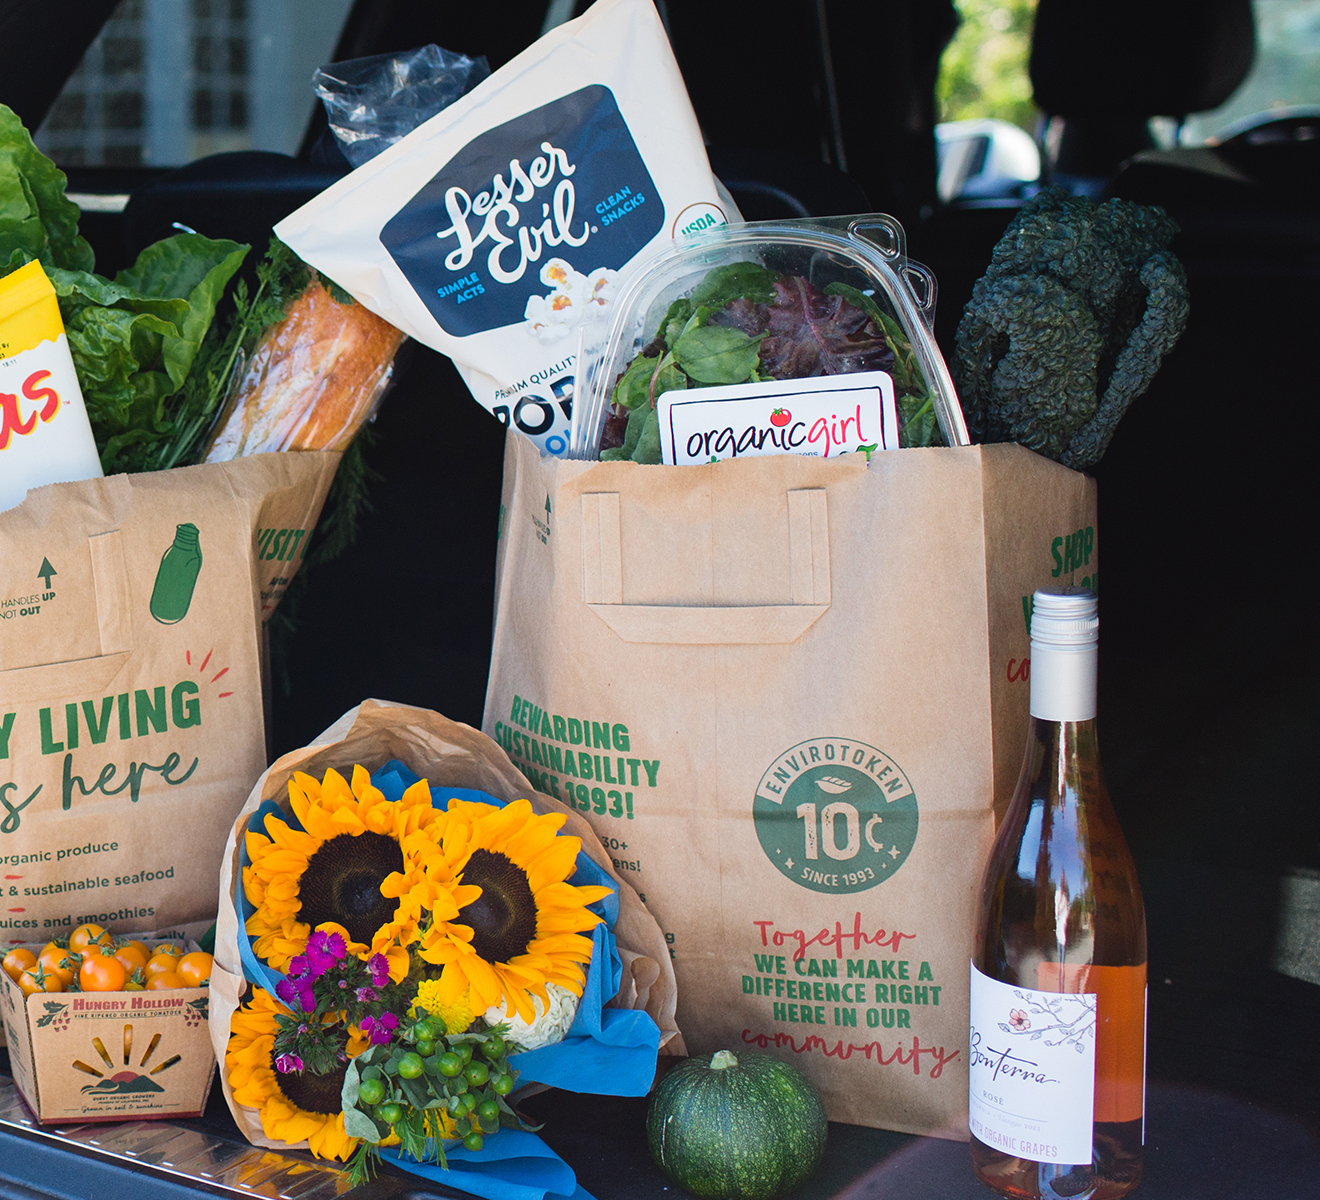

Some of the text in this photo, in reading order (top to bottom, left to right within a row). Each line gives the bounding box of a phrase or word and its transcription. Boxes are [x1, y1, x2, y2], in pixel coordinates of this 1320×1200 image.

[436, 141, 576, 271] Lesser
[594, 185, 632, 215] CLEAN
[600, 192, 646, 227] SNACKS
[437, 271, 480, 299] SIMPLE
[457, 284, 486, 304] ACTS
[686, 404, 868, 458] organicgirl
[257, 528, 306, 562] VISIT
[1051, 526, 1094, 578] SHOP
[1, 594, 40, 609] HANDLES
[41, 591, 56, 602] UP
[20, 605, 41, 617] OUT
[38, 680, 202, 756] LIVING
[510, 694, 631, 752] REWARDING
[495, 720, 661, 788] SUSTAINABILITY
[765, 743, 904, 795] ENVIROTOKEN
[63, 752, 199, 812] here
[565, 781, 635, 820] 1993!
[796, 801, 884, 861] 10¢
[56, 841, 119, 862] produce
[8, 885, 19, 897] &
[23, 876, 110, 897] sustainable
[114, 866, 175, 887] seafood
[800, 867, 876, 887] SINCE 1993
[43, 915, 72, 928] and
[76, 907, 155, 925] smoothies
[753, 911, 917, 963] Together
[753, 953, 934, 982] WE CAN MAKE A
[741, 975, 942, 1006] DIFFERENCE RIGHT
[773, 1002, 911, 1029] HERE IN OUR
[741, 1029, 962, 1079] community.
[970, 1026, 1057, 1084] Bonterra
[982, 1089, 1004, 1106] ROSÉ
[984, 1126, 1017, 1150] ORGANIC
[1020, 1140, 1058, 1158] GRAPES
[1024, 1123, 1041, 1132] 2021
